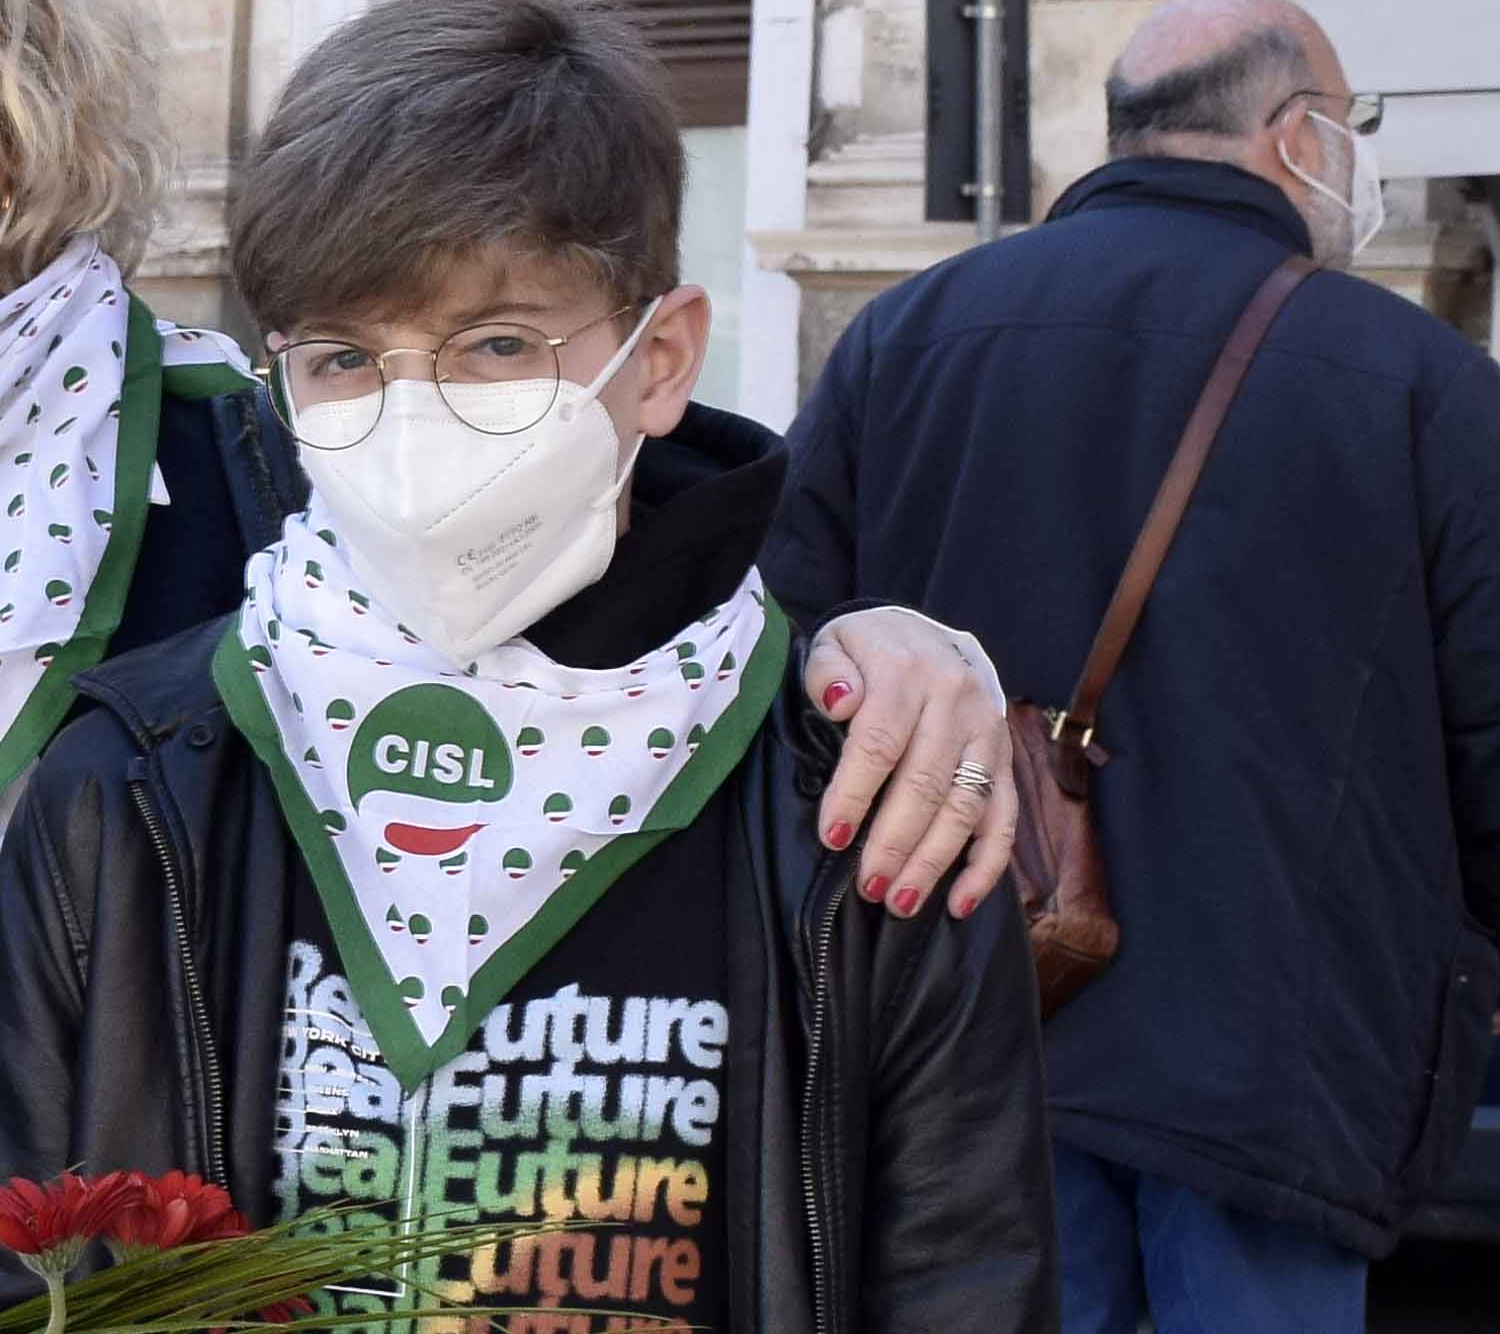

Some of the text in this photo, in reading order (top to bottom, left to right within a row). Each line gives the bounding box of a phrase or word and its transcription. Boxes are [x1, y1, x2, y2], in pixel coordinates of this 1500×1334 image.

[374, 734, 495, 788] CISL
[351, 1045, 382, 1062] CIT
[472, 982, 729, 1069] uture
[426, 1051, 721, 1147] Future
[423, 1129, 709, 1227] Future
[415, 1205, 703, 1306] Future
